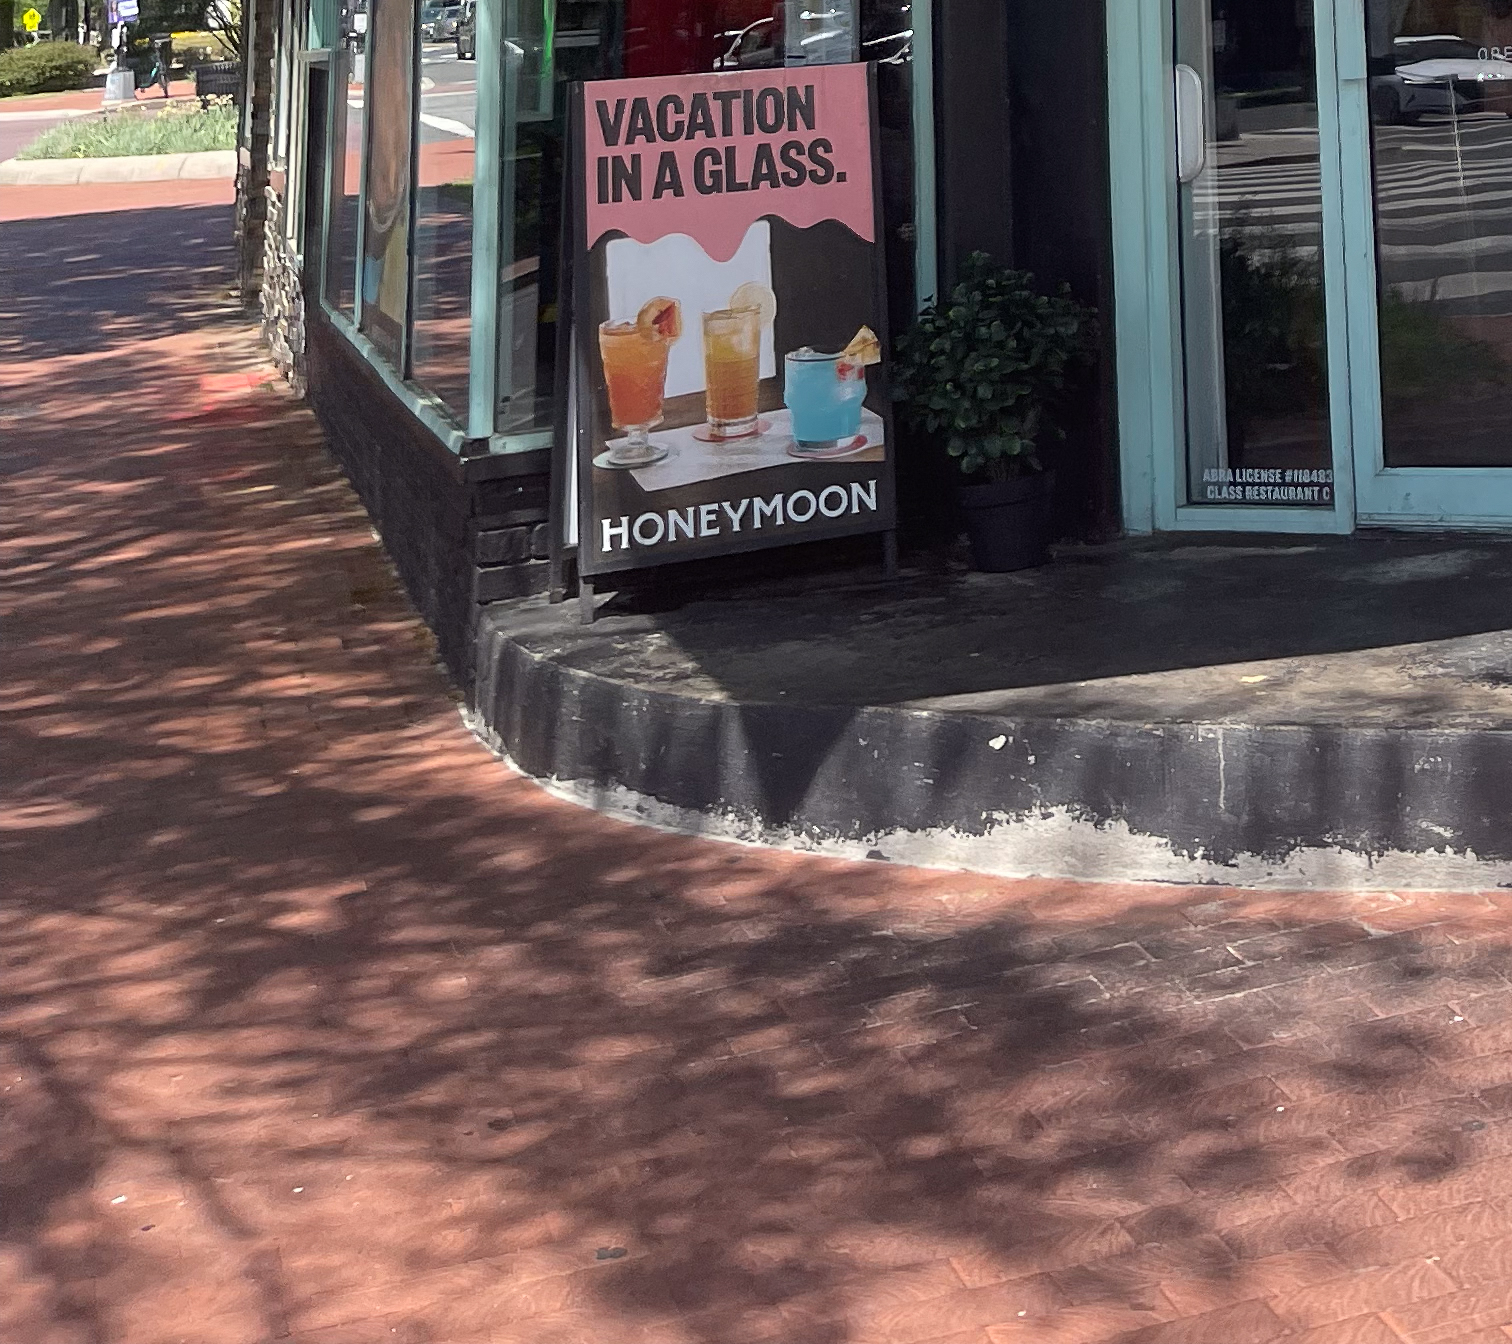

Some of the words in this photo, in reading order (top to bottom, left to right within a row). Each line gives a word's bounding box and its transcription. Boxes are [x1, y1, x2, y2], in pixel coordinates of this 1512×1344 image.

[595, 84, 817, 146] VACATION
[596, 153, 642, 205] IN
[651, 151, 684, 200] A
[693, 139, 848, 195] GLASS.
[1203, 468, 1233, 482] ABRA
[1236, 468, 1283, 482] LICENSE
[1207, 485, 1243, 499] CLASS
[1245, 486, 1320, 500] RESTAURANT
[1322, 486, 1330, 500] C
[600, 479, 879, 552] HONEYMOON
